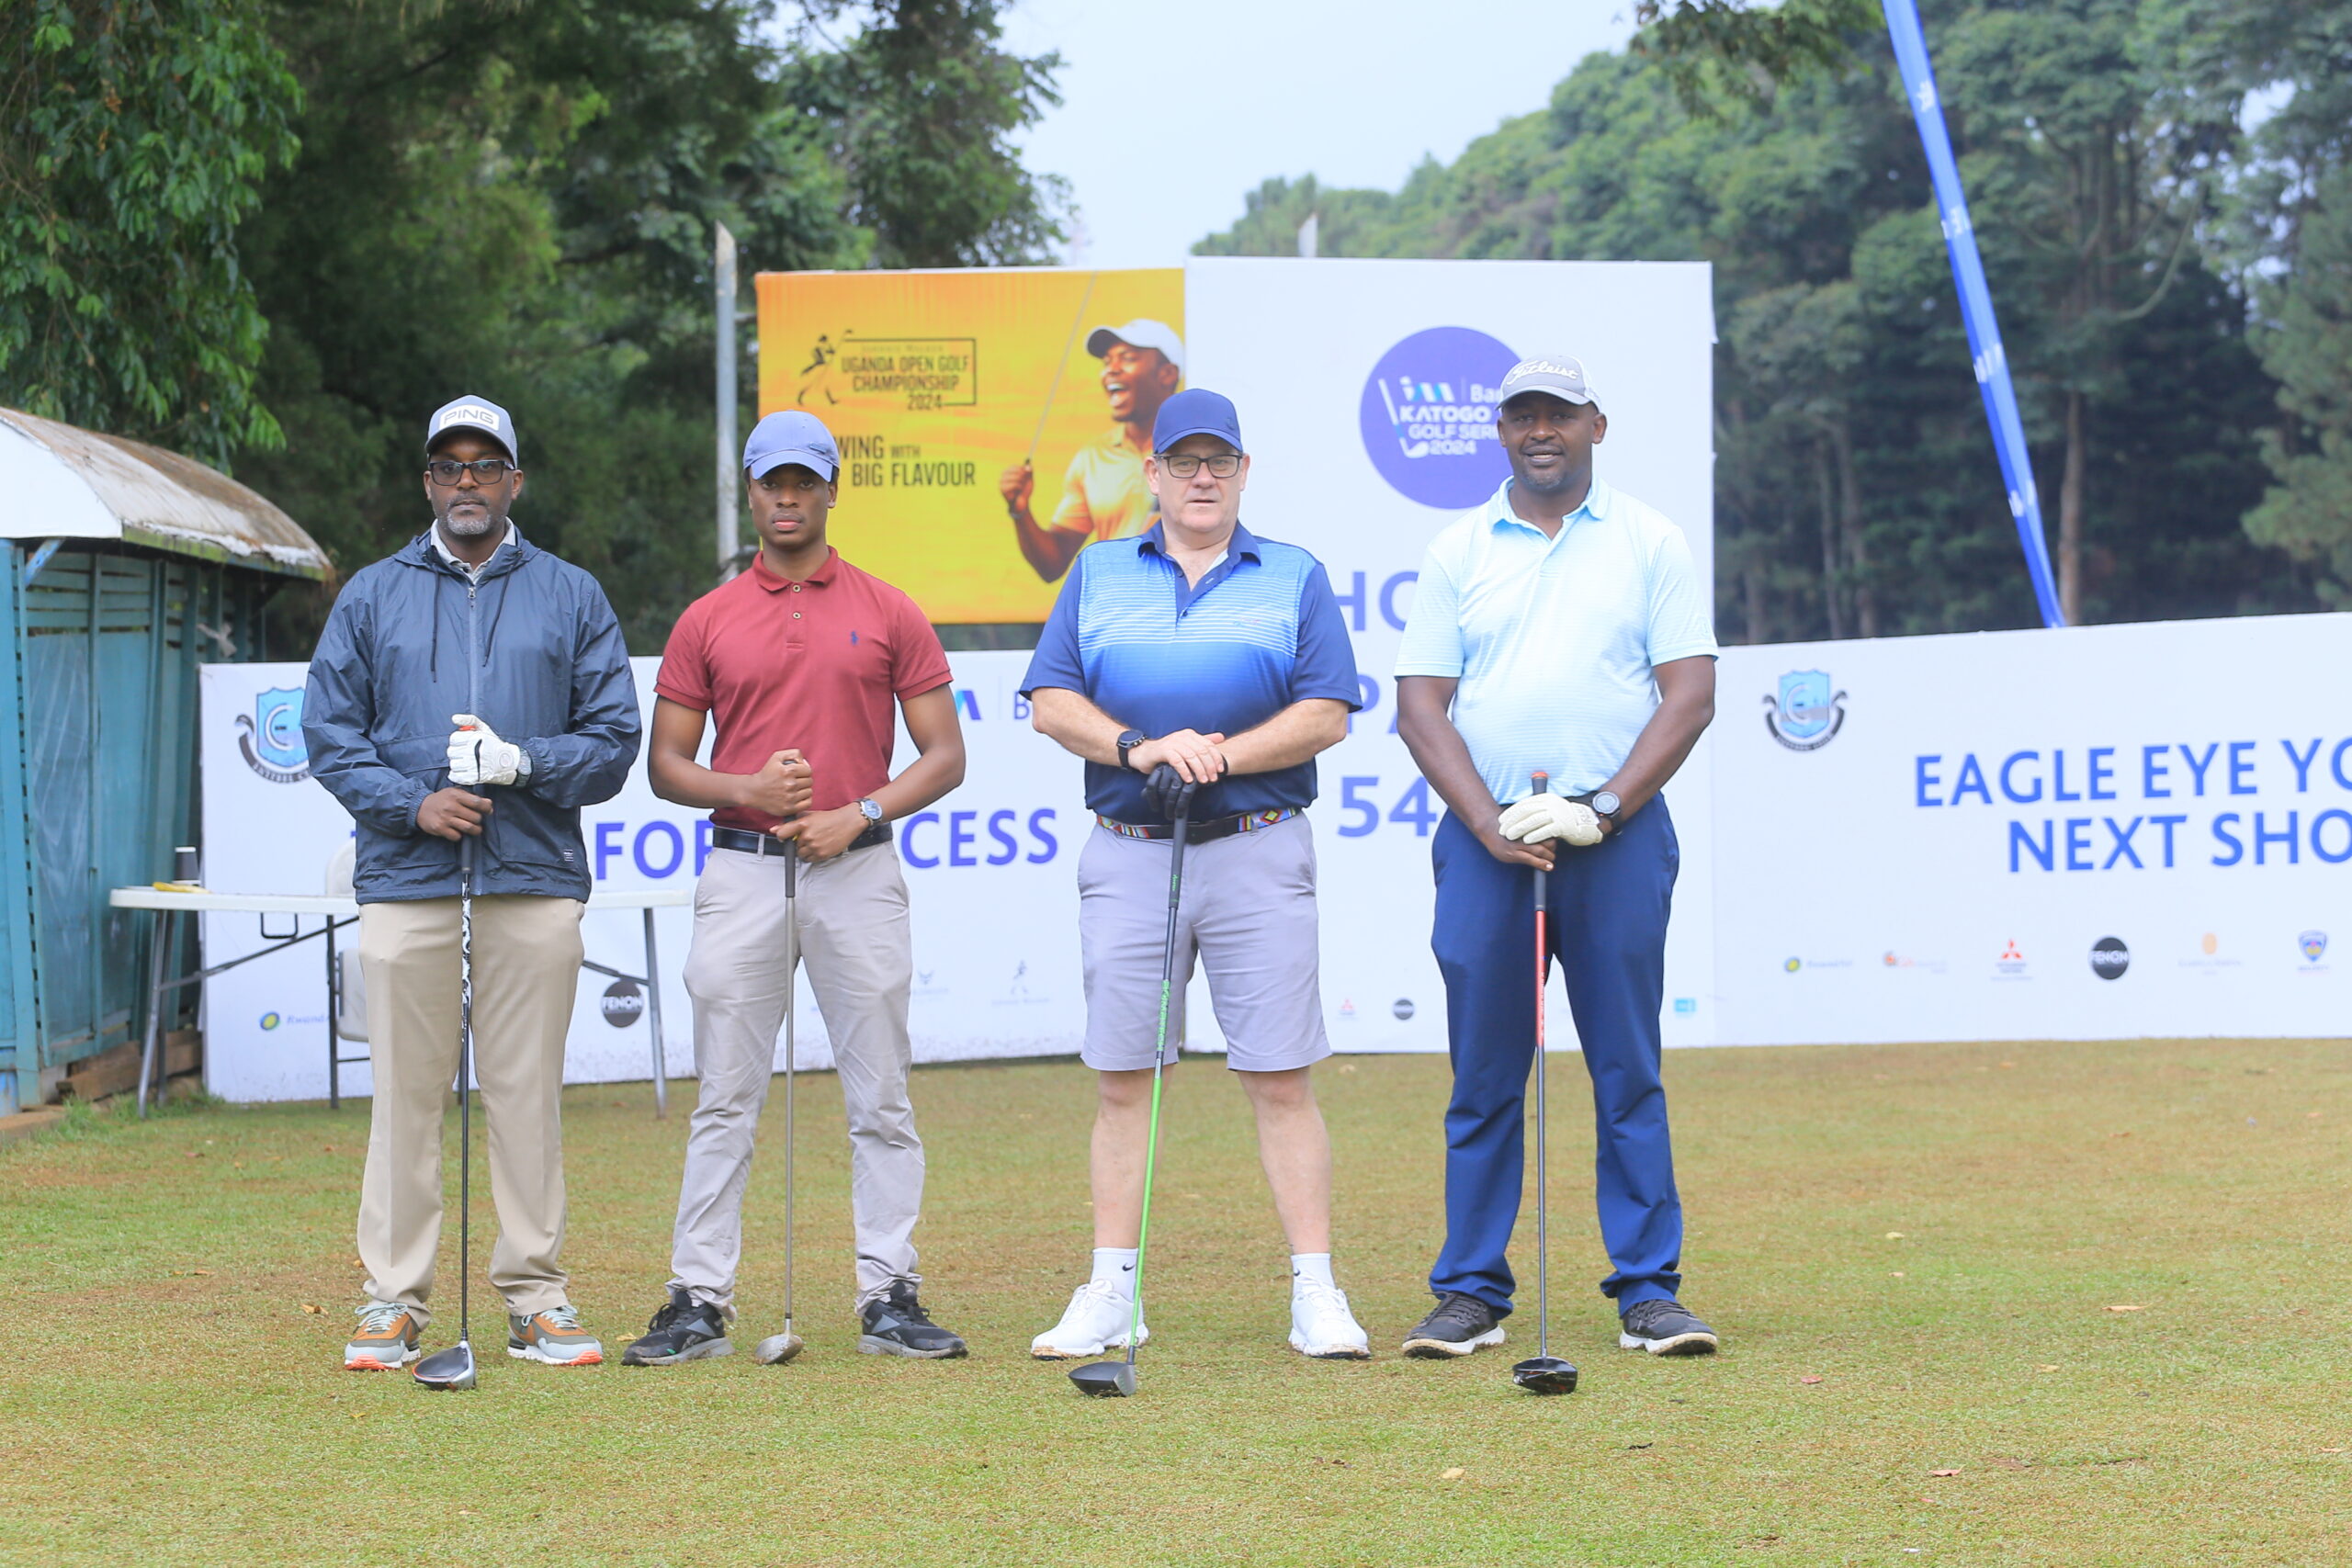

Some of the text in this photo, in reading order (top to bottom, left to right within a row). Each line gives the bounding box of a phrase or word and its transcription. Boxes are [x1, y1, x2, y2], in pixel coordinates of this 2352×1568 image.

[842, 355, 968, 373] UGANDA OPEN GOLF
[1507, 360, 1579, 386] Titleist
[853, 375, 959, 392] CHAMPIONSHIP
[908, 394, 942, 411] 2024
[444, 409, 493, 424] PING
[1399, 405, 1491, 423] KATOGO
[1408, 423, 1498, 440] GOLF SERI
[834, 435, 884, 459] WING
[1430, 439, 1477, 456] 2024
[852, 462, 976, 487] BIG FLAVOUR
[1916, 747, 2116, 808] EAGLE
[2143, 741, 2257, 799] EYE
[900, 807, 1058, 869] CESS
[2008, 815, 2188, 874] NEXT
[602, 995, 643, 1010] FENON
